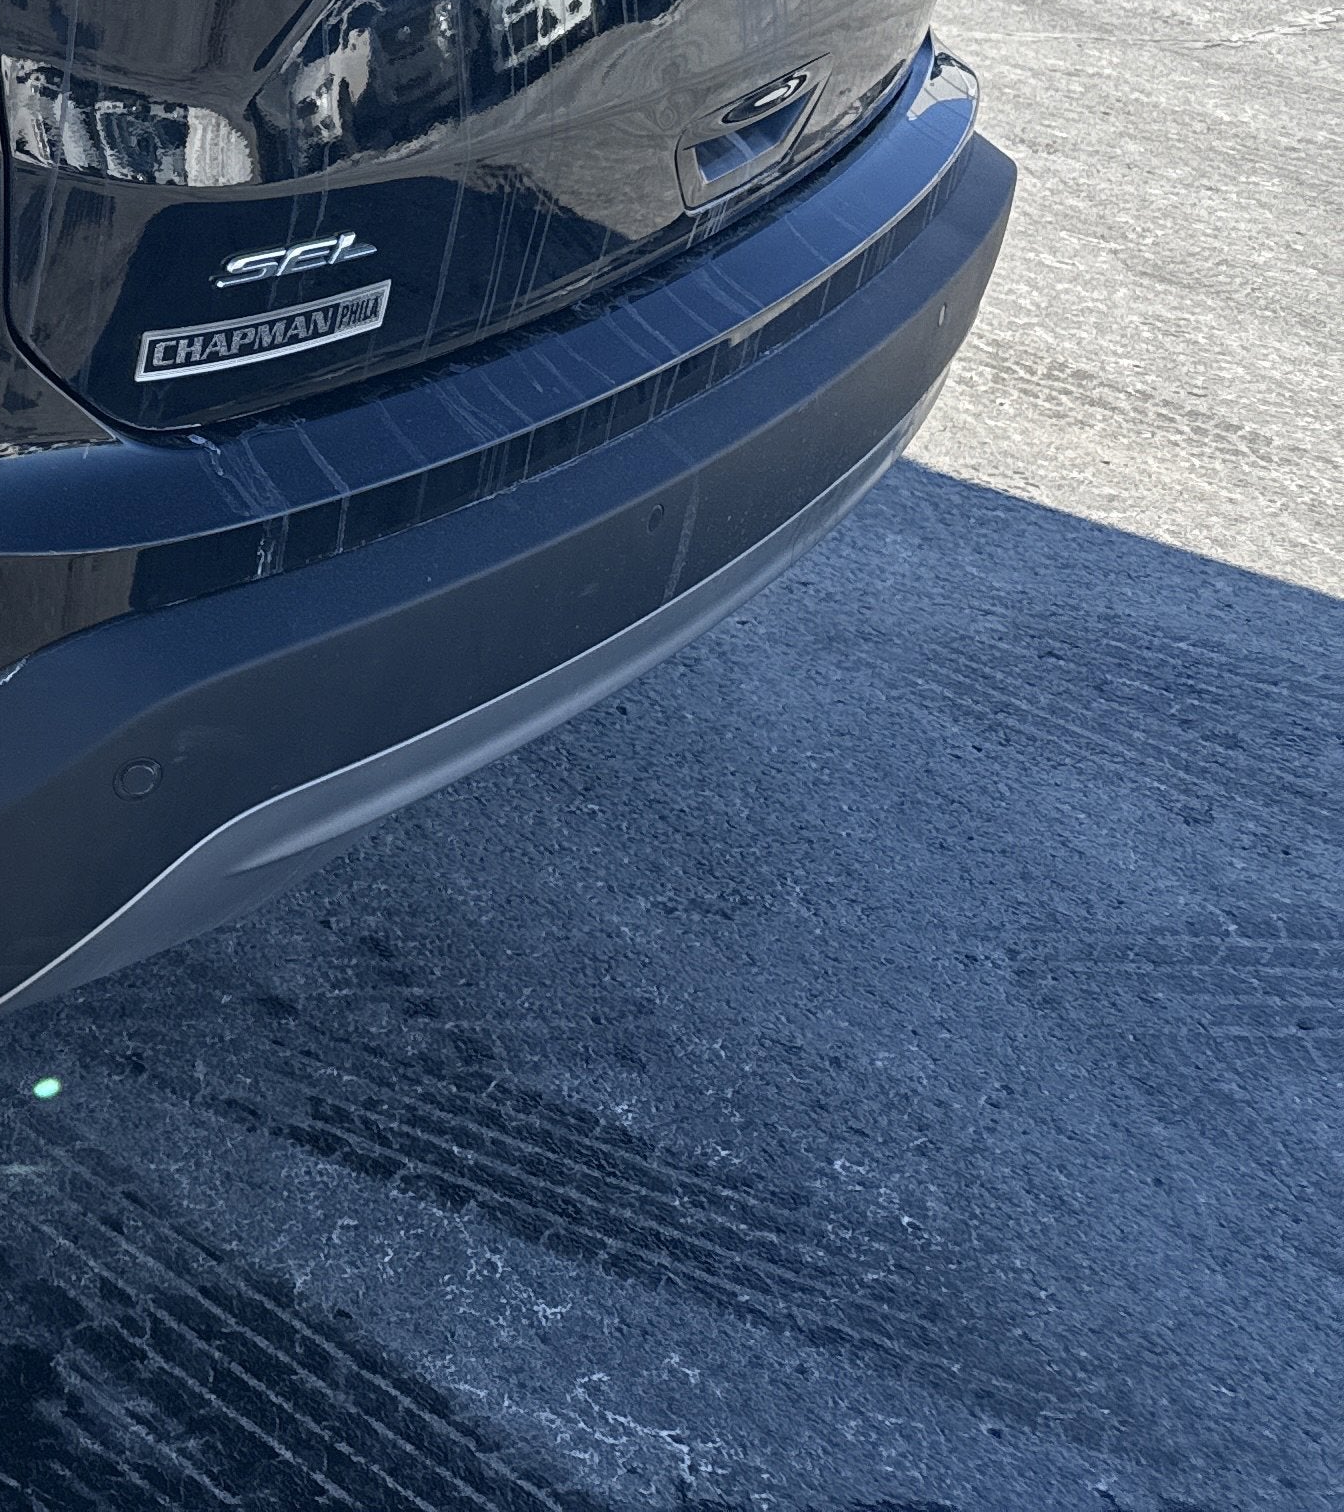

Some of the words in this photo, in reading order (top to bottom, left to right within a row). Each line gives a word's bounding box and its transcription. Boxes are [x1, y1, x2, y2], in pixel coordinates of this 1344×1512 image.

[211, 232, 378, 288] SEL
[152, 307, 334, 367] CHAPMAN
[339, 296, 381, 332] PHILA
